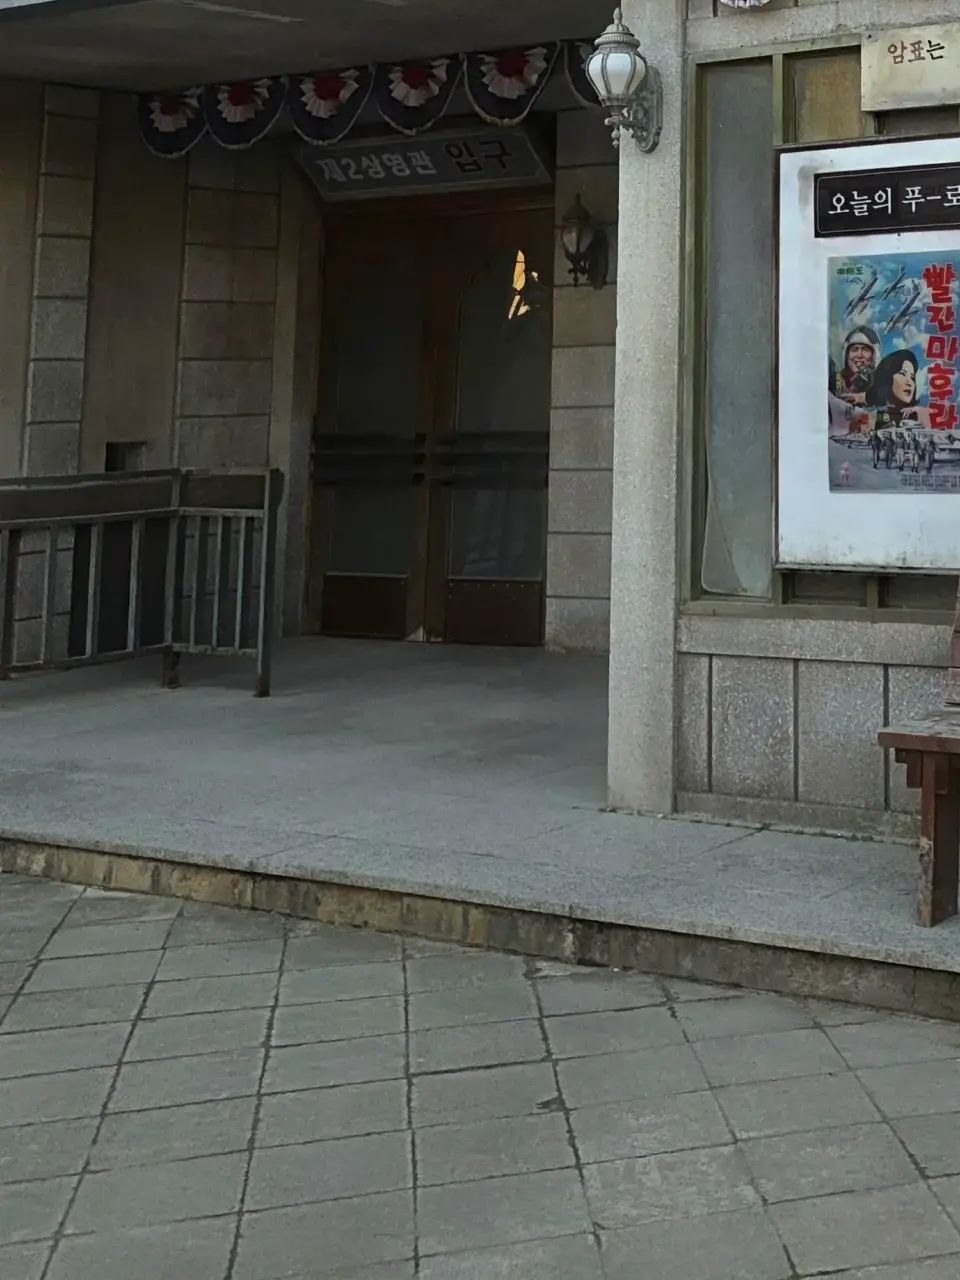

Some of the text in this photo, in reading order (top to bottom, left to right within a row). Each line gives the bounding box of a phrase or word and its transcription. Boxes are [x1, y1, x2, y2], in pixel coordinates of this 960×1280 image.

[886, 39, 946, 64] 암표는
[444, 140, 512, 173] 입구
[828, 187, 893, 216] 오늘의
